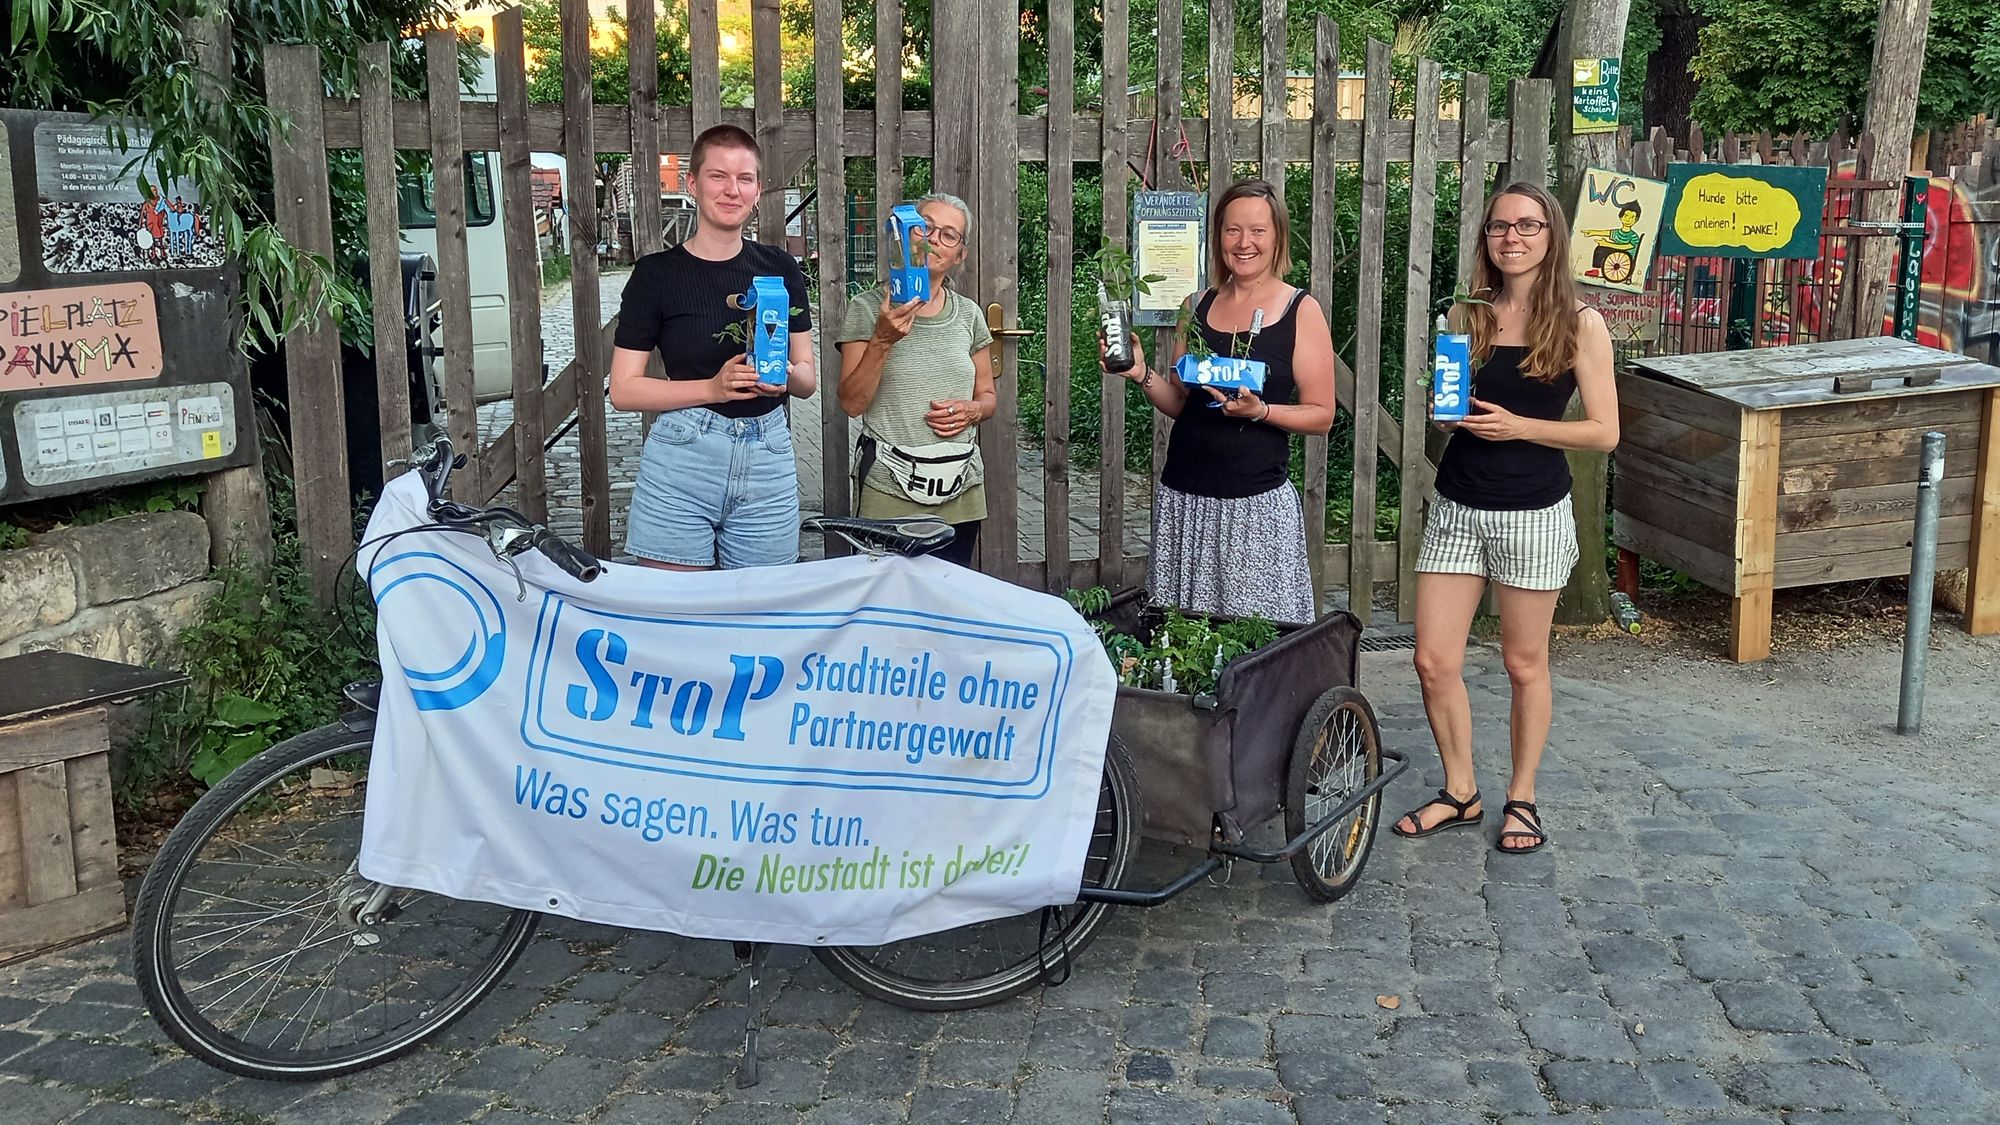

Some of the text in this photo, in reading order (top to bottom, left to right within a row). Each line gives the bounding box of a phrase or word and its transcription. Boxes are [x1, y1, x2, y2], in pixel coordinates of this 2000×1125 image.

[1574, 96, 1615, 107] Kartoffel-
[1582, 87, 1608, 96] keine
[1588, 174, 1636, 209] WC
[1699, 189, 1758, 205] Hunde bitte
[908, 475, 963, 497] FILA
[796, 645, 1039, 710] Stadtteile ohne
[788, 702, 1016, 764] Partnergewalt
[515, 765, 870, 847] Was sagen. Was tun.
[691, 853, 745, 891] Die
[755, 846, 891, 894] Neustadt
[899, 850, 936, 889] ist
